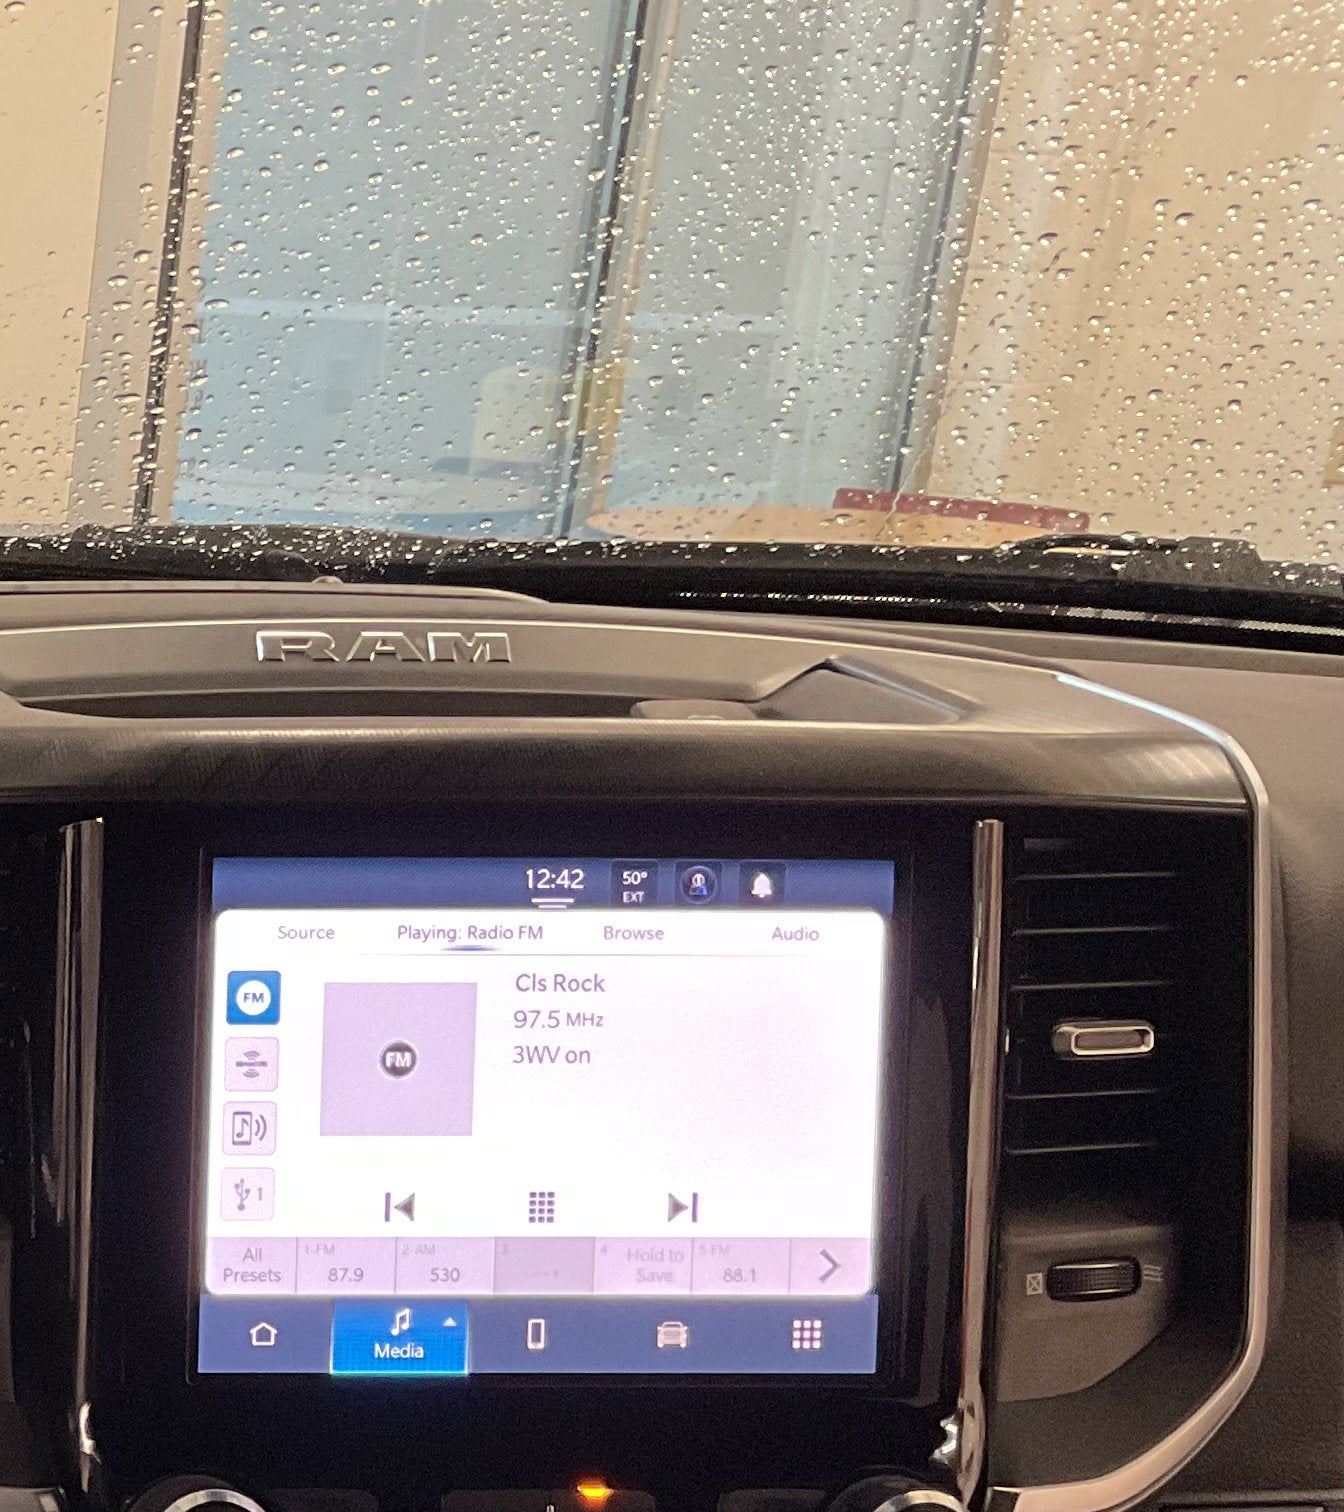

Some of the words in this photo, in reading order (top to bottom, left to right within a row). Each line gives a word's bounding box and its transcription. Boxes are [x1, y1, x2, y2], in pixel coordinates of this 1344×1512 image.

[256, 631, 512, 663] RAM
[525, 868, 585, 889] 12:42
[622, 891, 645, 903] EXT
[278, 926, 335, 940] Source
[398, 925, 462, 943] Playing:
[468, 925, 513, 940] Radio
[519, 926, 543, 939] FM
[604, 925, 664, 940] Browse
[772, 926, 819, 941] Audio
[515, 973, 547, 993] Cls
[553, 973, 605, 993] Rock
[243, 993, 264, 1003] FM
[513, 1010, 560, 1028] 97.5
[566, 1012, 604, 1027] MHz
[385, 1052, 412, 1067] FM
[512, 1045, 561, 1064] 3WV
[565, 1050, 591, 1064] on
[242, 1247, 263, 1262] All
[627, 1248, 665, 1262] Hold
[667, 1249, 685, 1262] to
[223, 1267, 281, 1283] Presets
[327, 1268, 364, 1283] 87.9
[429, 1268, 460, 1283] 530
[636, 1269, 674, 1283] Save
[723, 1269, 757, 1283] 88.1
[374, 1343, 424, 1359] Media
